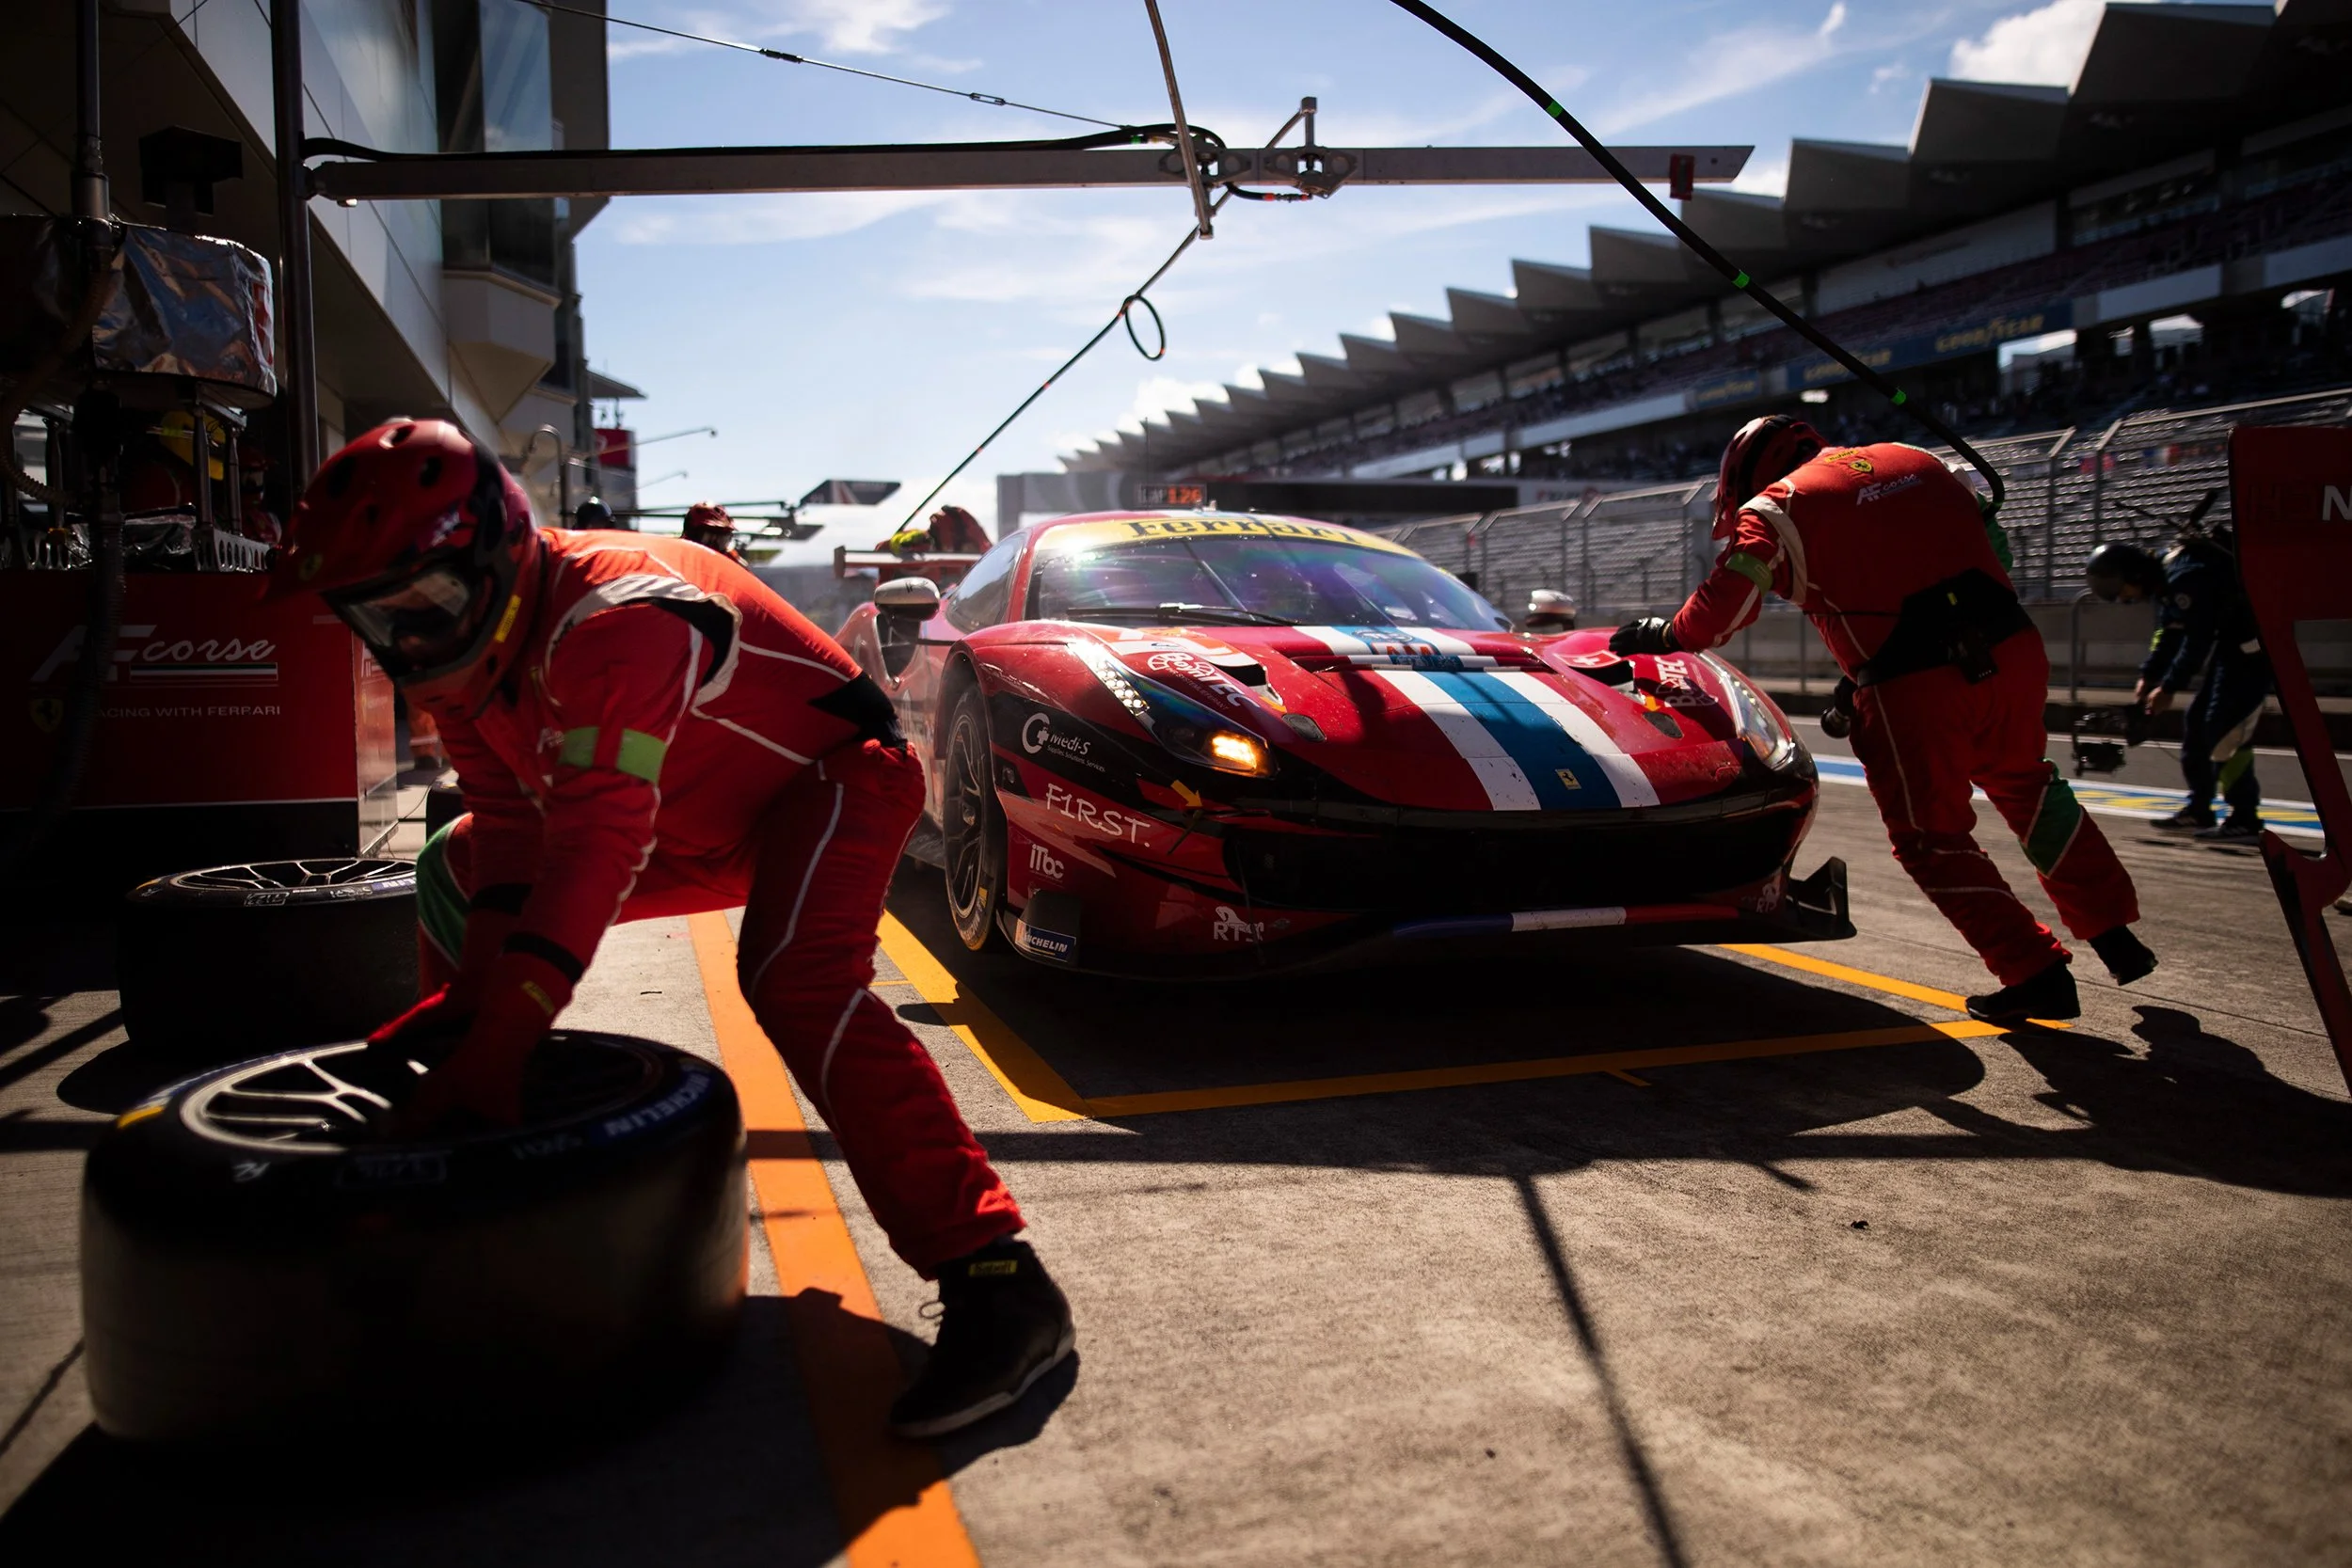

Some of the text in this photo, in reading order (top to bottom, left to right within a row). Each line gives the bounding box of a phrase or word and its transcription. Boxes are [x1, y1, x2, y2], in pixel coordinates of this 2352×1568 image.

[1121, 519, 1362, 545] Ferrari
[141, 638, 278, 662] corse
[97, 705, 281, 719] ACING WITH FERRARI
